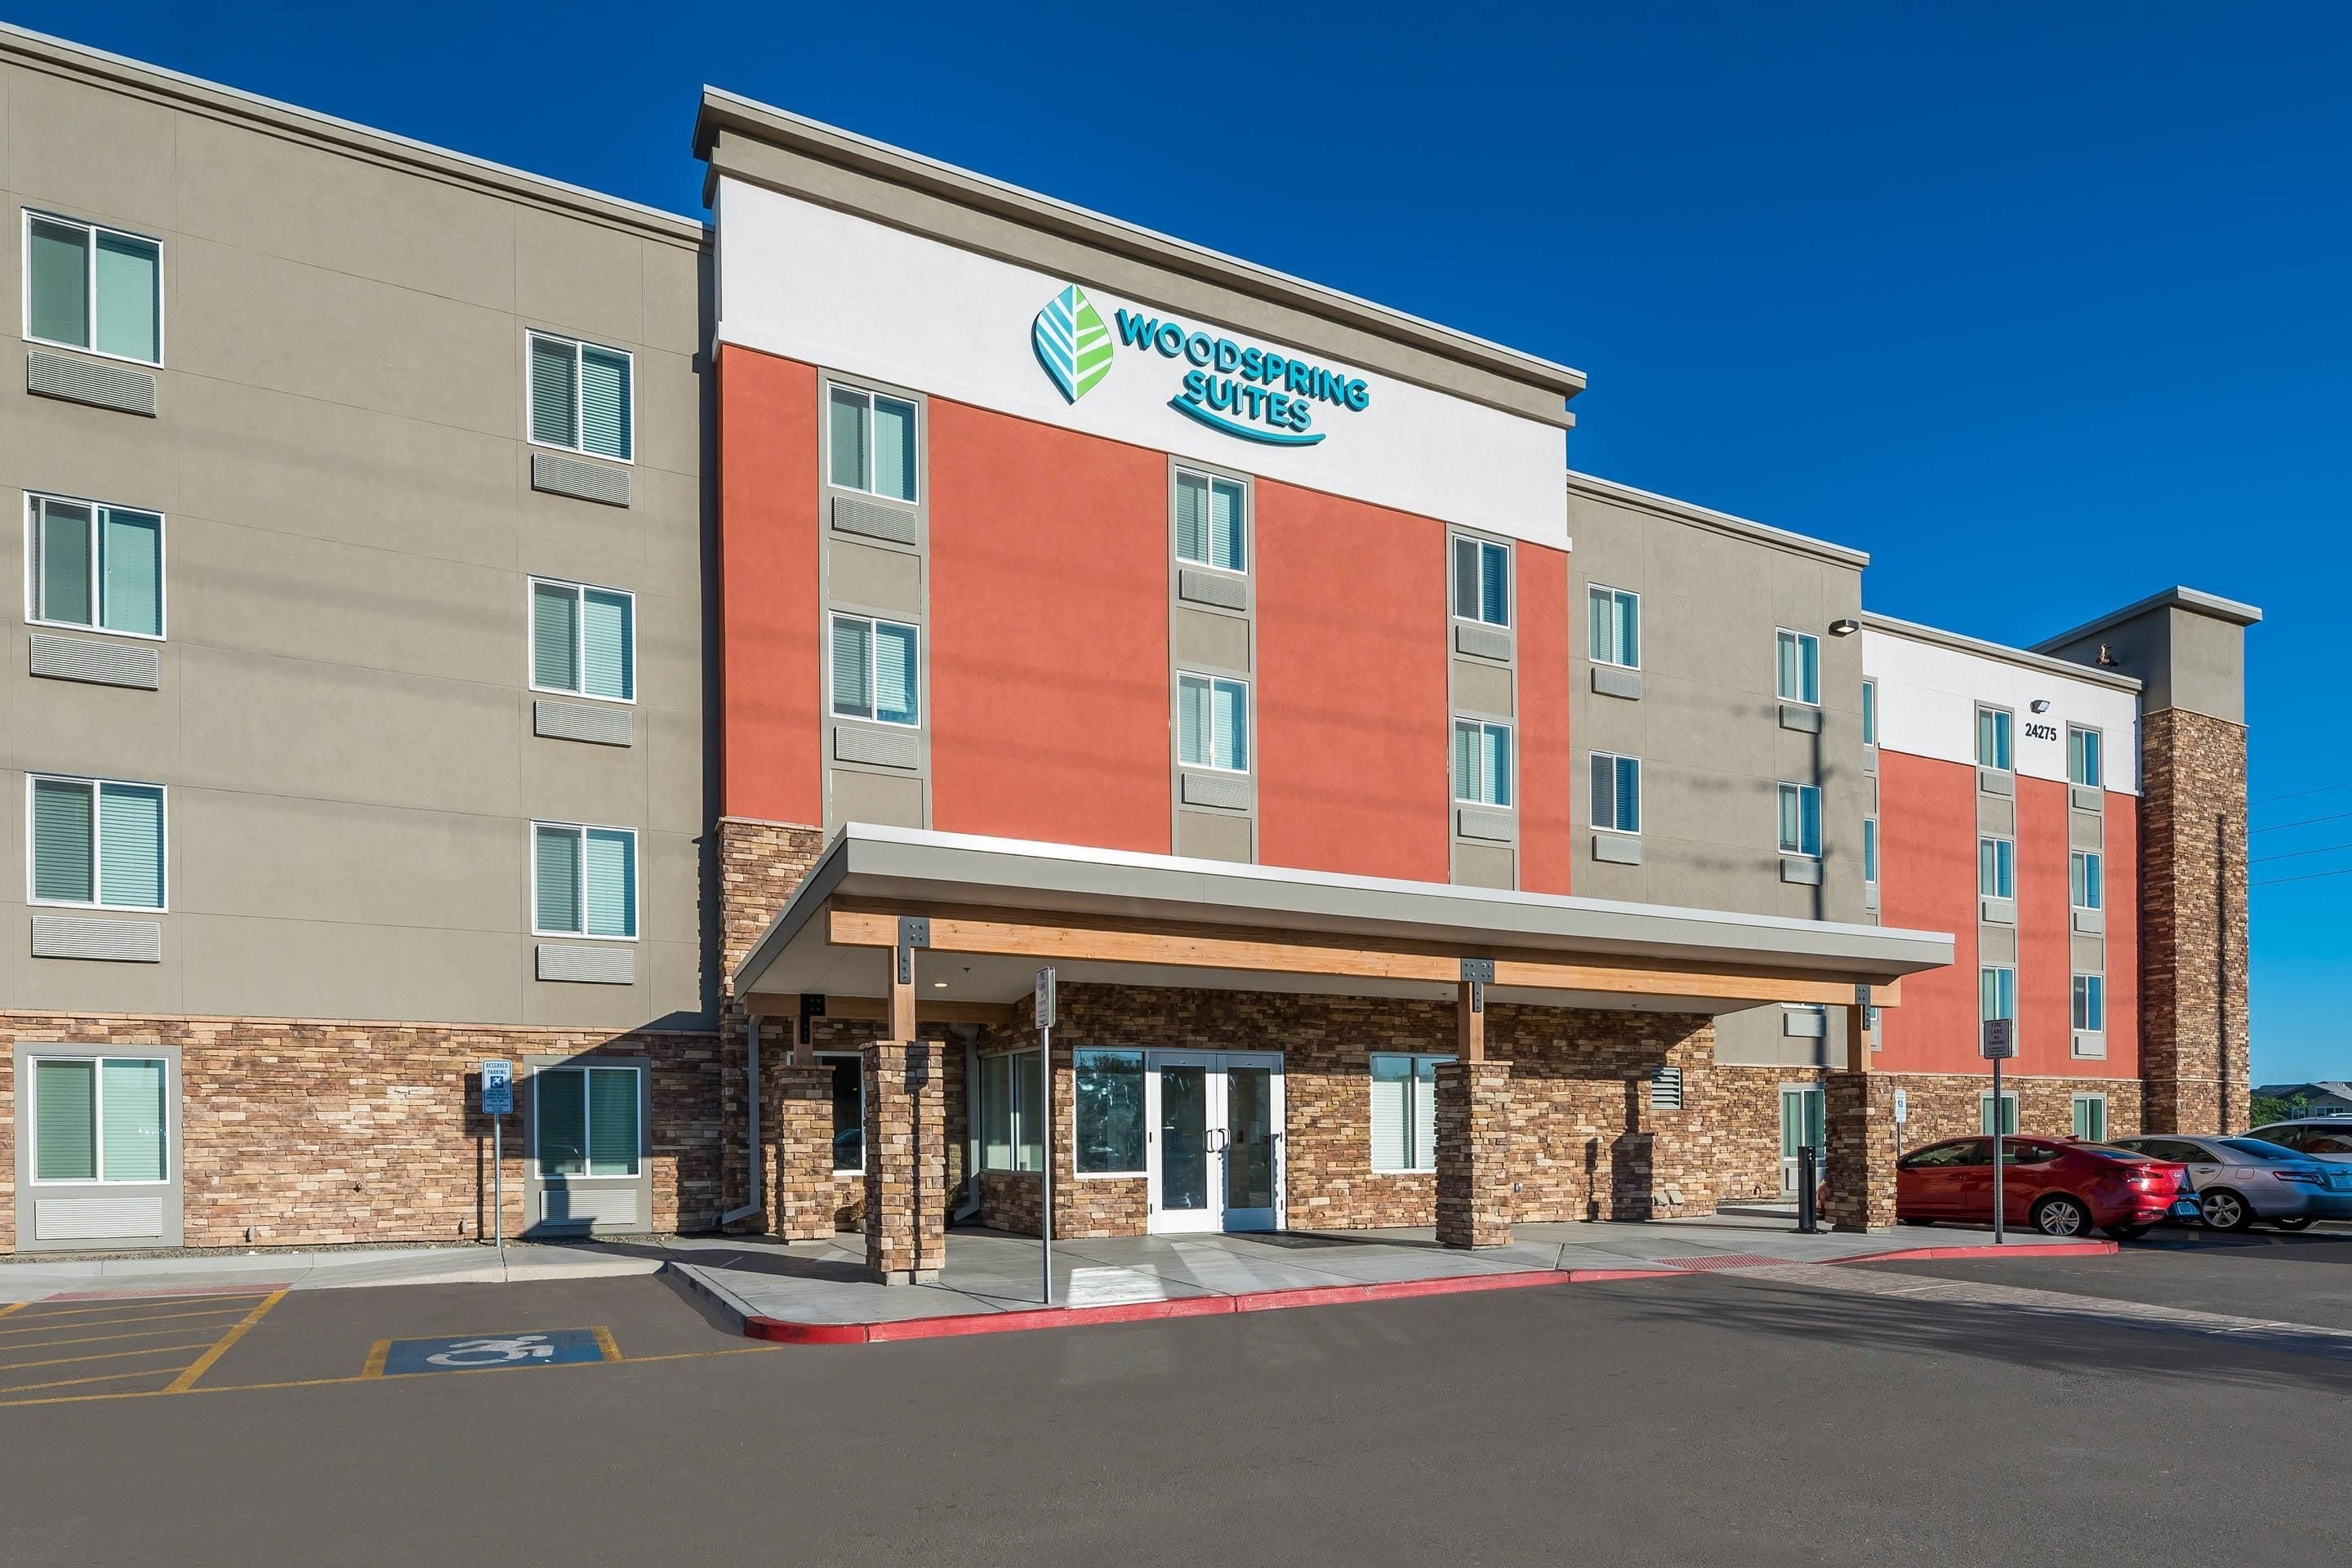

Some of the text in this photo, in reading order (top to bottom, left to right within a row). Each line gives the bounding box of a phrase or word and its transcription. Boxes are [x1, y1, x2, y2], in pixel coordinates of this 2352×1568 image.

[1115, 309, 1369, 412] WOODSPRING
[1183, 369, 1312, 432] SUITES
[2025, 723, 2057, 742] 24275
